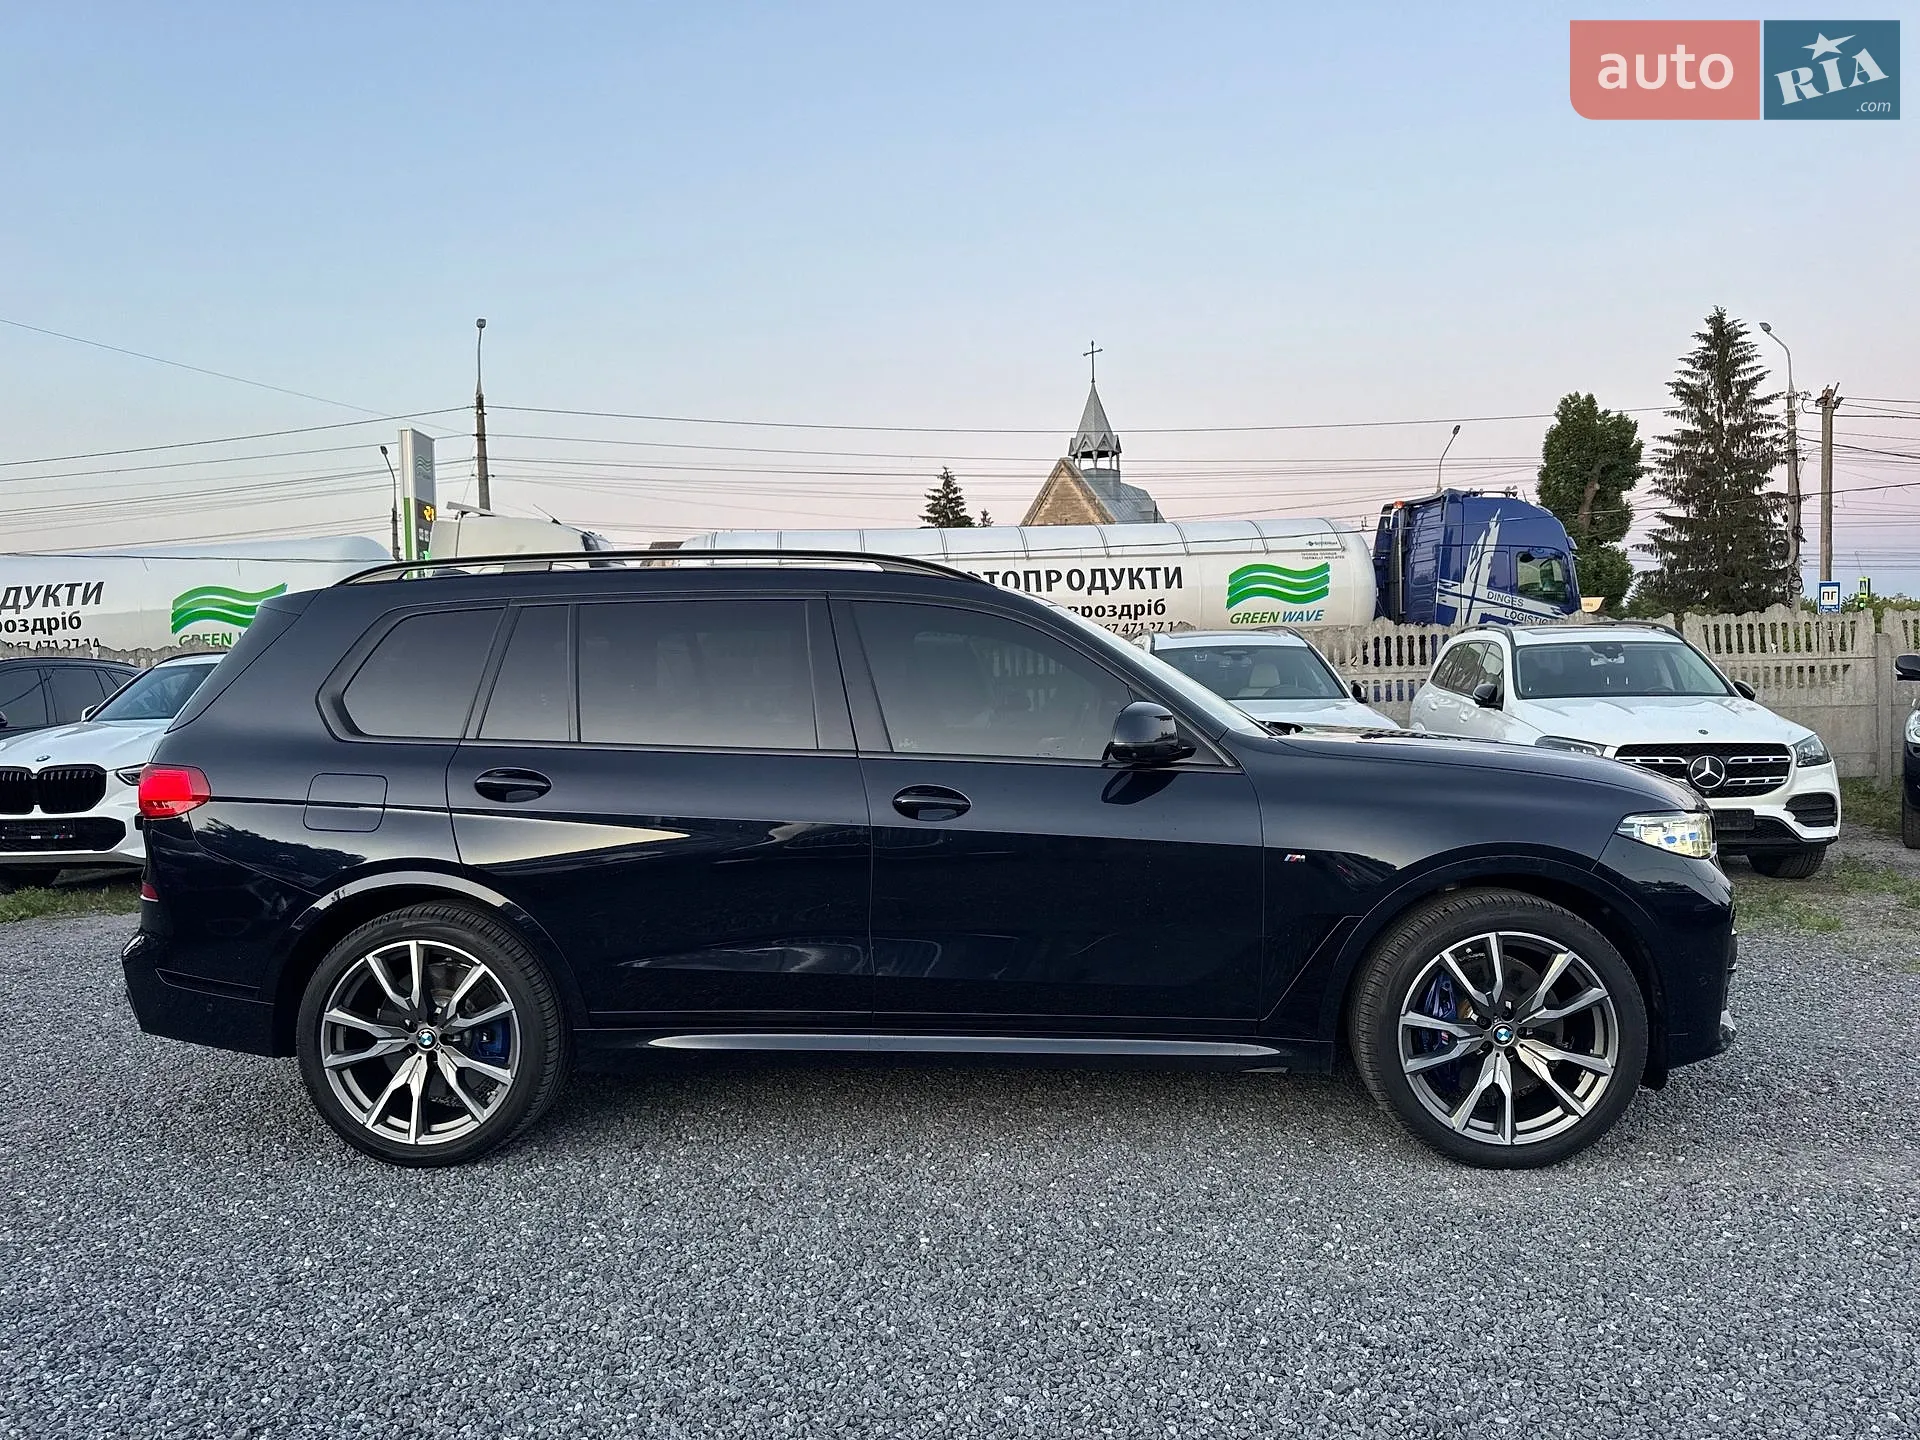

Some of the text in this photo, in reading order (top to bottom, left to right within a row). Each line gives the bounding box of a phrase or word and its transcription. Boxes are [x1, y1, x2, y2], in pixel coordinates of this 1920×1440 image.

[967, 566, 1183, 595] ТОПРОДУКТИ
[1487, 591, 1524, 607] DINGES
[0, 610, 82, 636] оздріб
[1230, 609, 1325, 624] GREEN WAVE
